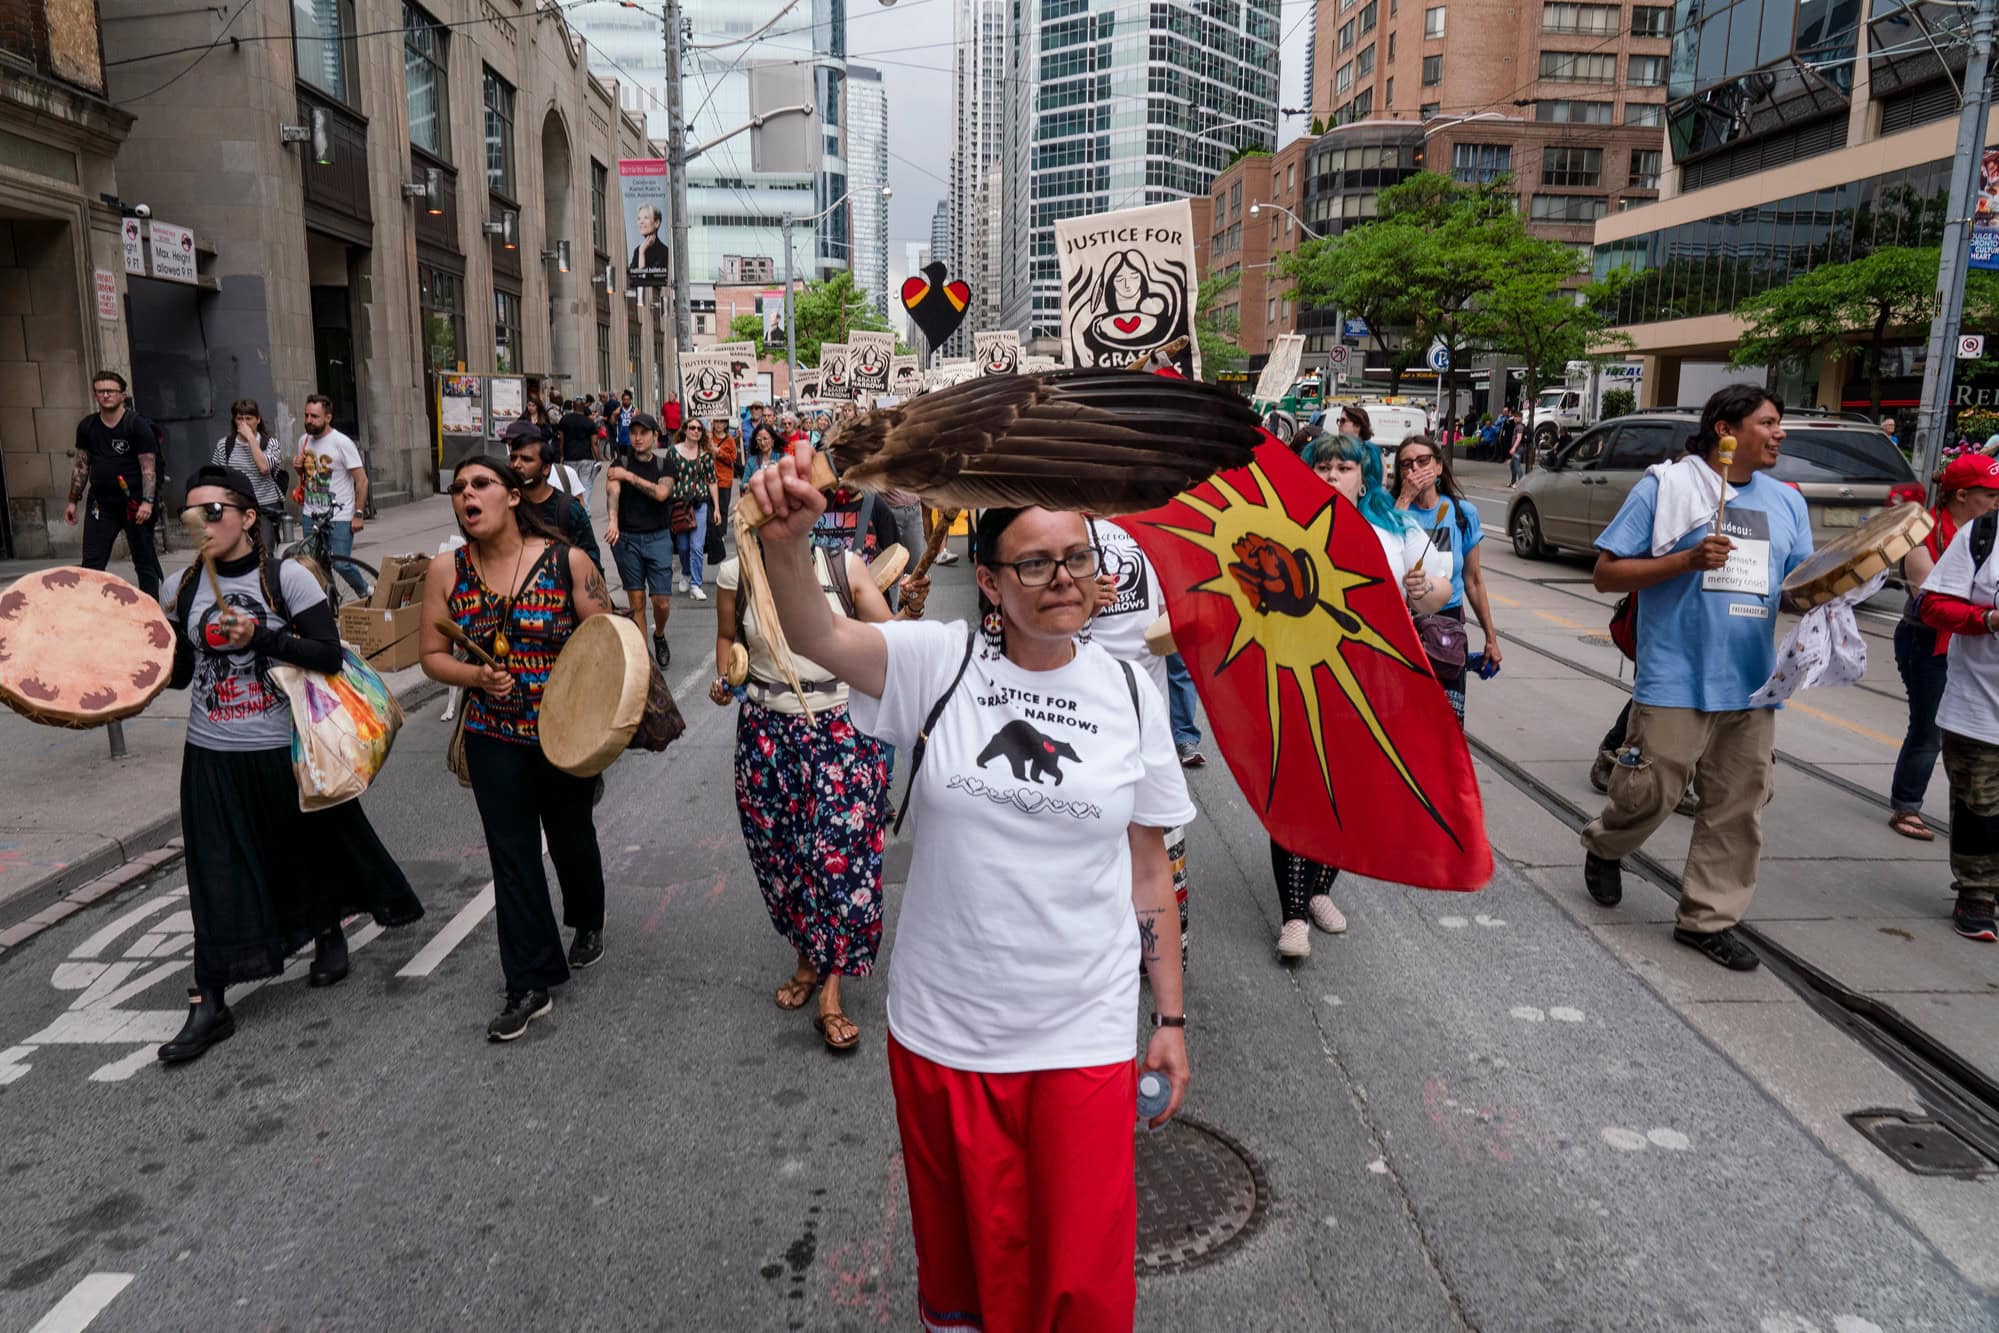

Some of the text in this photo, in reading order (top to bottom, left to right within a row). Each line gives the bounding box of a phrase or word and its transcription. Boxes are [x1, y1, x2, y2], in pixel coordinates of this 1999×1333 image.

[1067, 228, 1183, 255] JUSTICE FOR
[156, 247, 170, 259] Max.
[1975, 246, 1999, 255] CULTUR
[879, 337, 891, 346] FOR
[977, 334, 1001, 343] JUSTICE
[684, 358, 729, 368] JUSTICE FOR
[857, 375, 881, 384] GRASSY
[851, 382, 885, 391] NARROWS
[823, 391, 850, 399] NARROWS
[691, 409, 729, 417] NARROWS
[1711, 520, 1752, 536] Tudeau:
[1722, 566, 1734, 574] for
[1708, 576, 1742, 587] mercury
[1101, 598, 1145, 615] ARROWS
[214, 676, 245, 702] WE
[208, 694, 276, 724] RESISTANCE
[1046, 697, 1078, 712] FOR
[976, 695, 1099, 735] GRAS NARROWS
